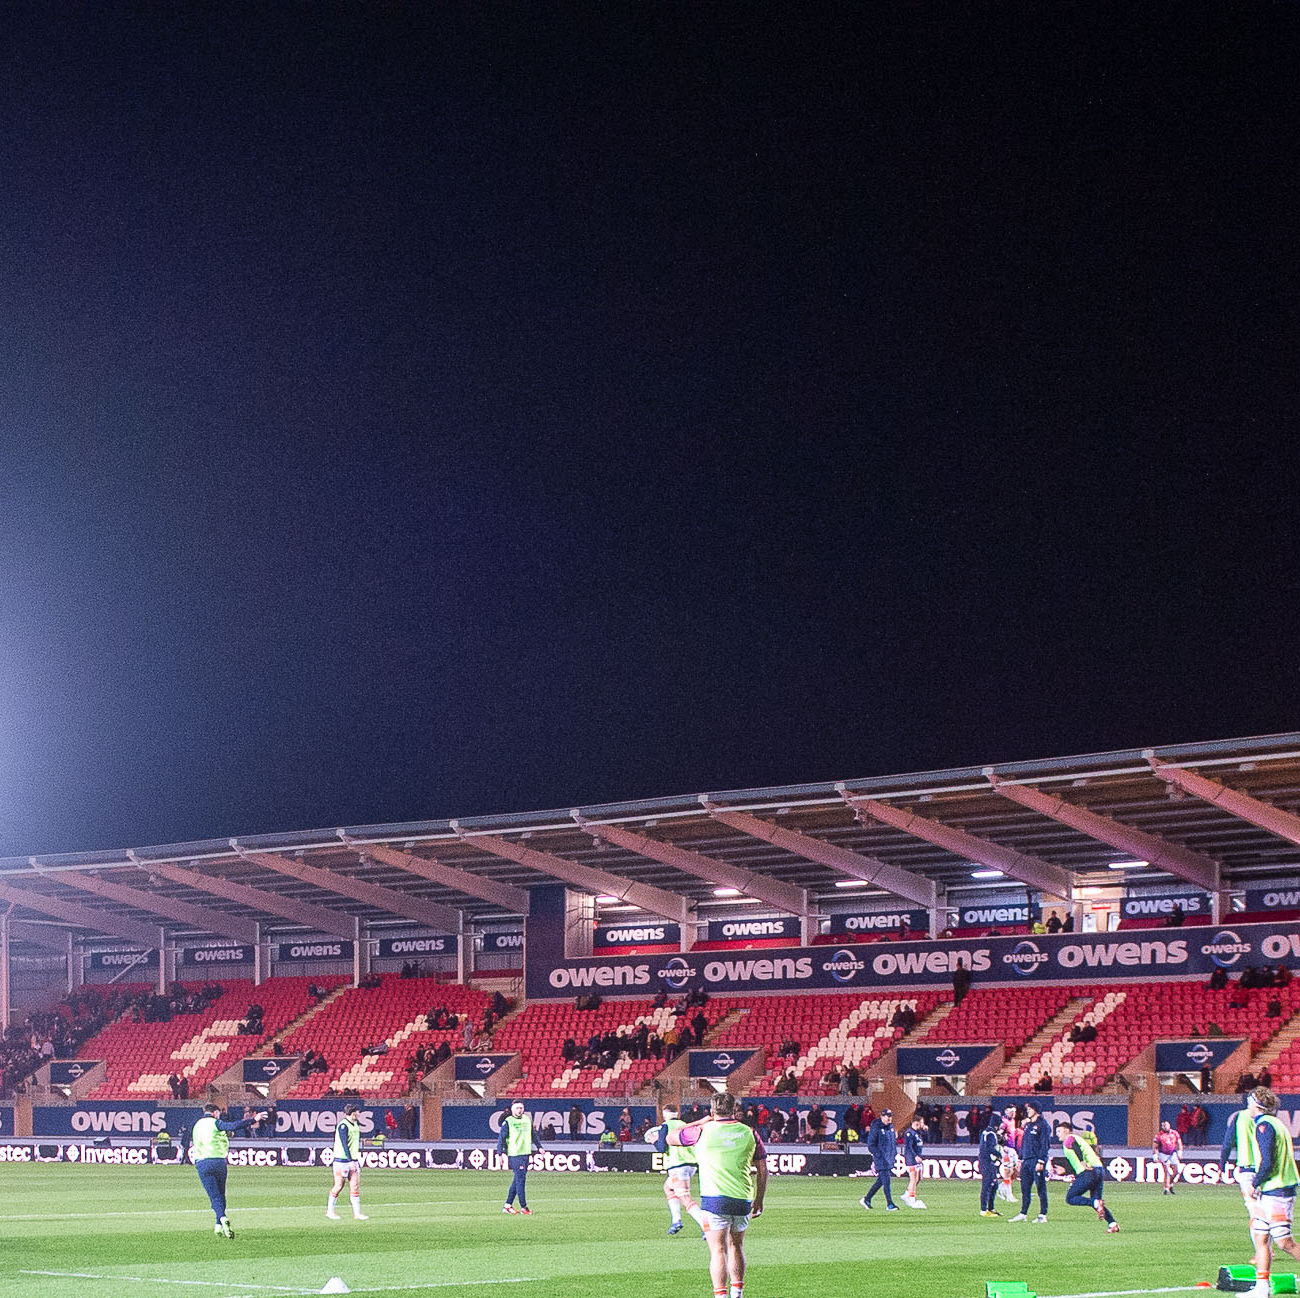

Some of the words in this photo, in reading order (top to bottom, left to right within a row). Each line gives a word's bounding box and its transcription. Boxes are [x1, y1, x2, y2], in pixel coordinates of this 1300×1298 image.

[964, 905, 1030, 923] owens
[1125, 897, 1200, 915] owens
[722, 920, 785, 936] owens
[845, 913, 911, 929] owens
[606, 927, 665, 942] owens
[194, 948, 244, 962] owens
[290, 943, 342, 958] owens
[391, 938, 445, 954] owens
[1057, 939, 1188, 968] owens
[1201, 943, 1252, 955] owens
[101, 951, 149, 965] owens
[822, 960, 865, 972] owens
[872, 949, 991, 976] owens
[1002, 951, 1049, 964] owens
[549, 963, 650, 988] owens
[657, 966, 697, 979] owens
[704, 956, 813, 983] owens
[71, 1111, 168, 1132] owens
[489, 1110, 606, 1135] oens
[80, 1145, 148, 1165] Investec
[227, 1149, 278, 1167] estec
[356, 1149, 421, 1169] vestec
[488, 1149, 581, 1172] Instec
[780, 1154, 807, 1173] CUP
[1135, 1157, 1242, 1184] Inest
